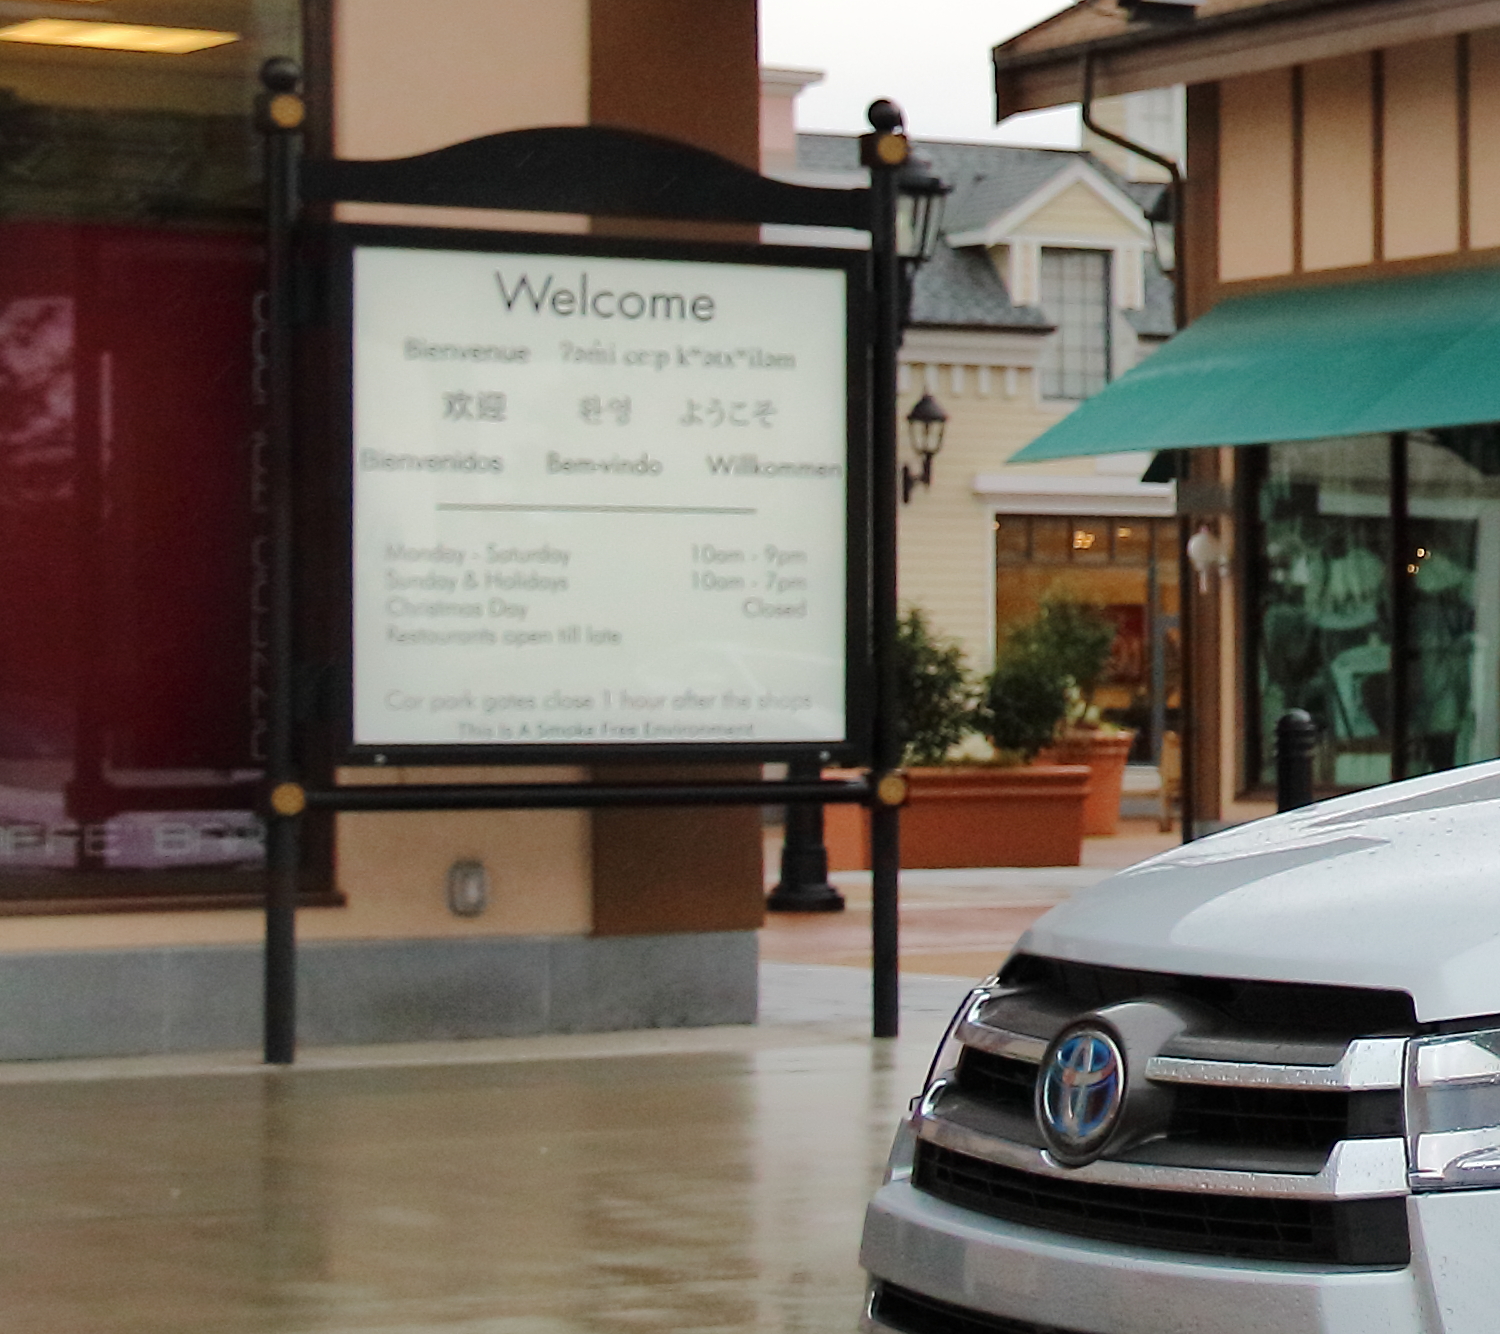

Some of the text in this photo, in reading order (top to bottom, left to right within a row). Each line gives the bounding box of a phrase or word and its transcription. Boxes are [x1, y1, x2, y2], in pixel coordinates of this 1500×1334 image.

[495, 270, 716, 323] Welcome
[403, 336, 532, 364] Bienvenue
[442, 389, 506, 422] 欢迎
[679, 397, 778, 429] ようこそ
[357, 444, 505, 476] Bienvenidos
[545, 450, 664, 477] Bem-vindo
[706, 452, 844, 481] Willkommen
